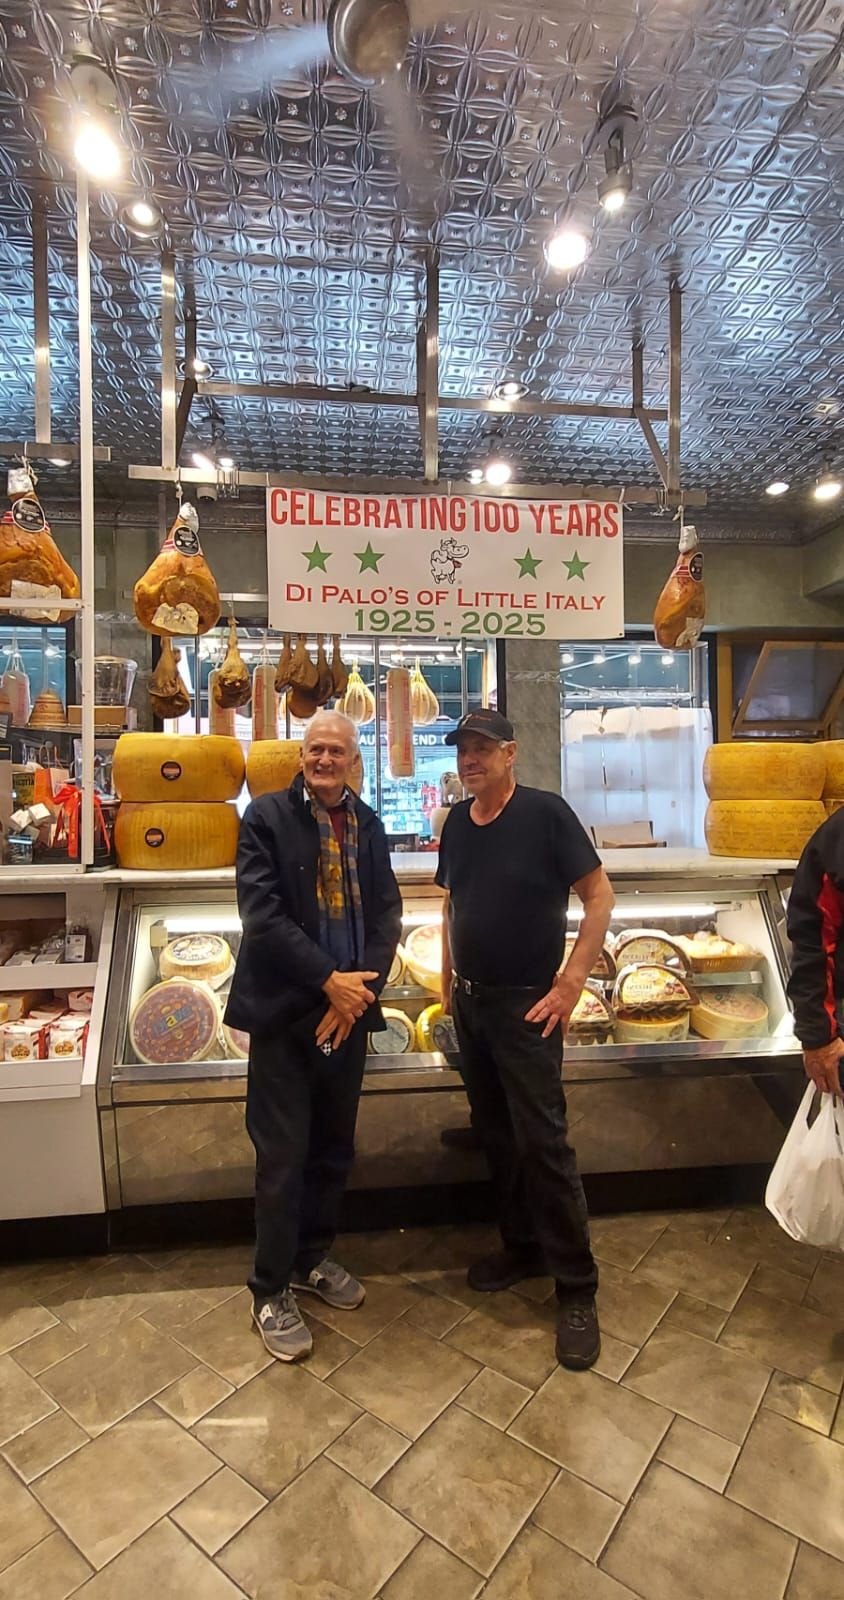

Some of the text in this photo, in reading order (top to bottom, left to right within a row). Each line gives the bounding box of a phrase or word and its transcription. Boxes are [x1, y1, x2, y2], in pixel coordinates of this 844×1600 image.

[271, 488, 618, 538] CELEBRATING 100 YEARS
[355, 609, 434, 632] 1925
[461, 612, 545, 635] 2025
